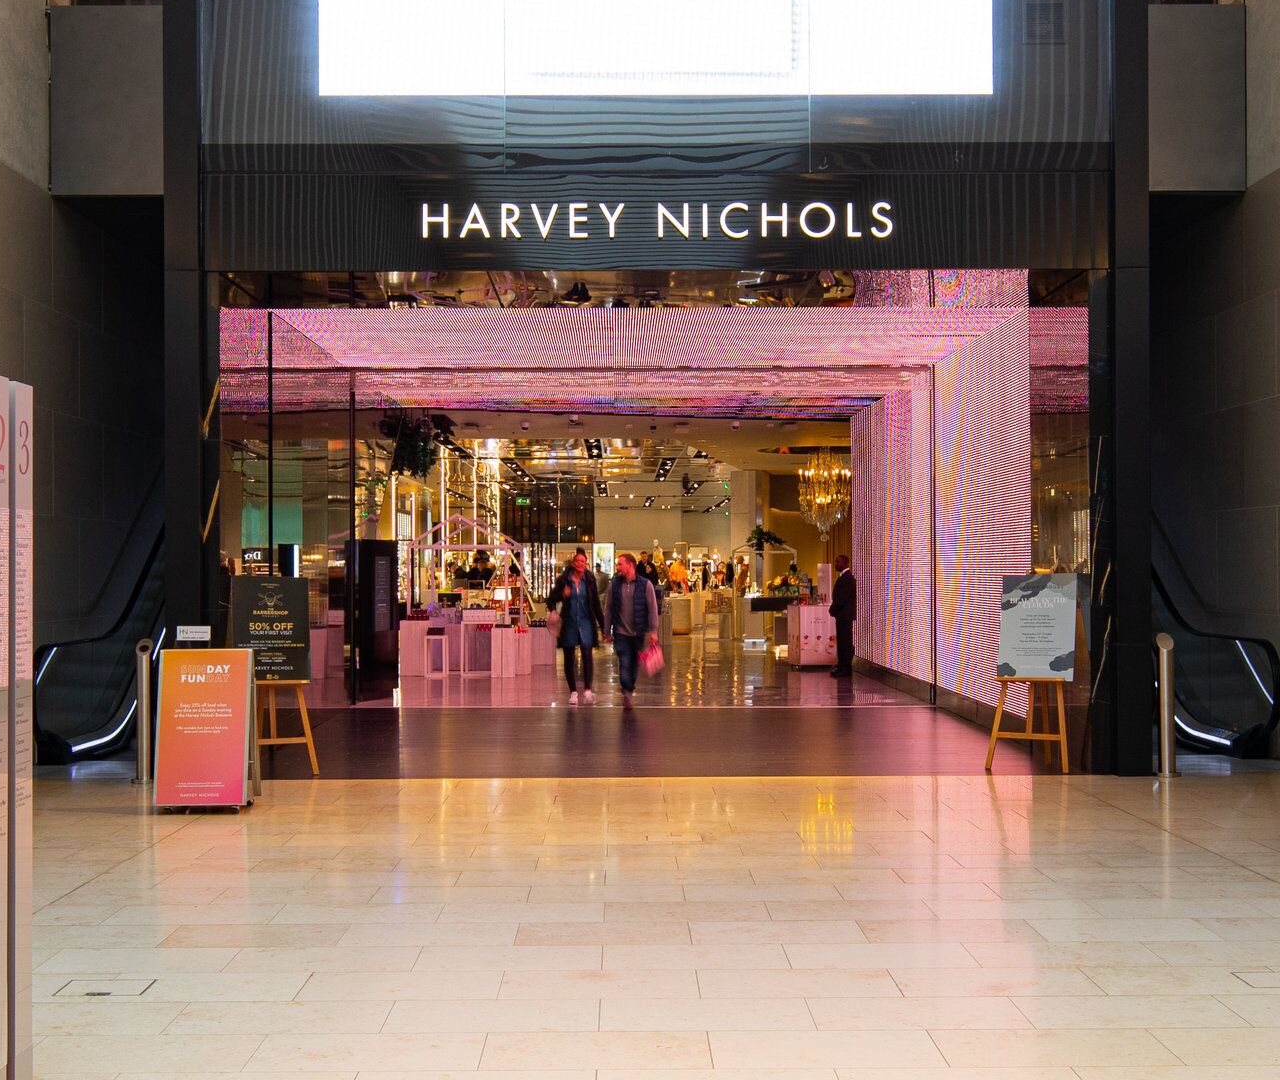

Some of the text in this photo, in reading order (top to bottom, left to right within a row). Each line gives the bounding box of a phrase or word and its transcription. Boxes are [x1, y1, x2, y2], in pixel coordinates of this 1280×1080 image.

[422, 201, 894, 239] HARVEY NICHOLS
[19, 420, 29, 475] 3
[249, 622, 294, 631] 50% OFF
[180, 664, 231, 674] SUNDAY
[180, 674, 231, 683] FUNDAY
